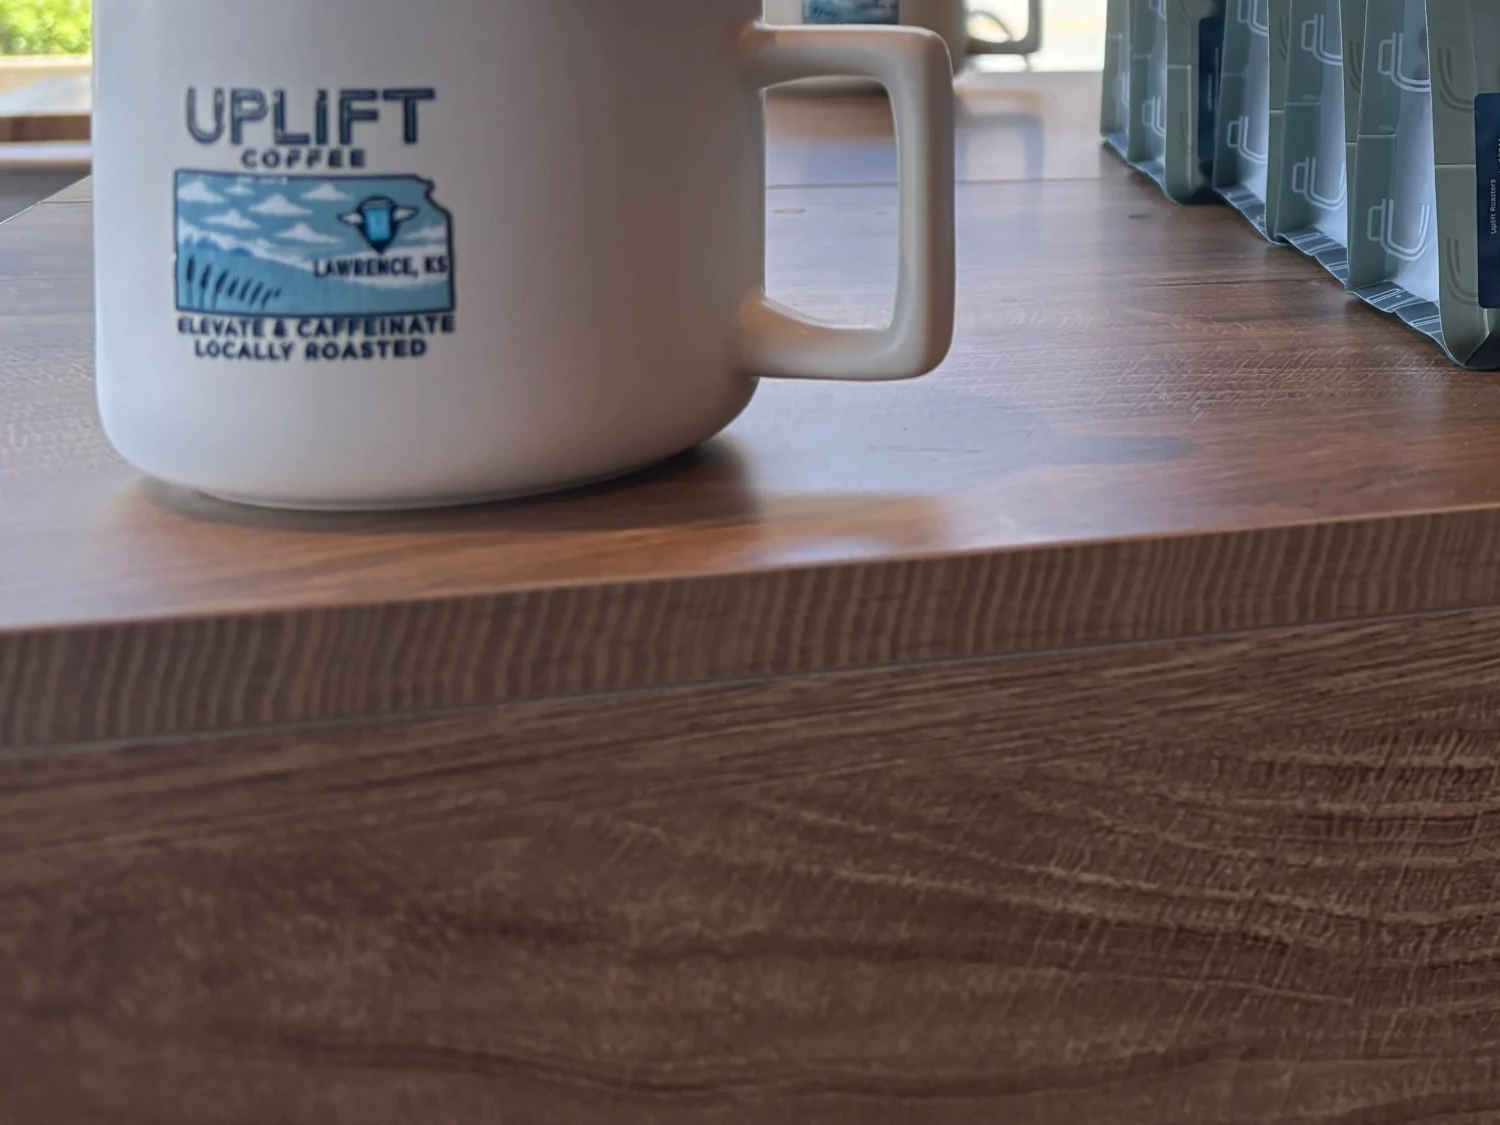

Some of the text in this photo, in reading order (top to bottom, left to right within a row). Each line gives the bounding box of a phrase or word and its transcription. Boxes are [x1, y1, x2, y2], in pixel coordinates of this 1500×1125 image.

[186, 87, 436, 146] UPLIFT
[241, 148, 367, 168] COFFEE
[313, 256, 448, 279] LAWRENCE, KS
[177, 315, 456, 338] ELEVATE & CAFFEINATE
[195, 339, 427, 361] LOCALLY ROASTED
